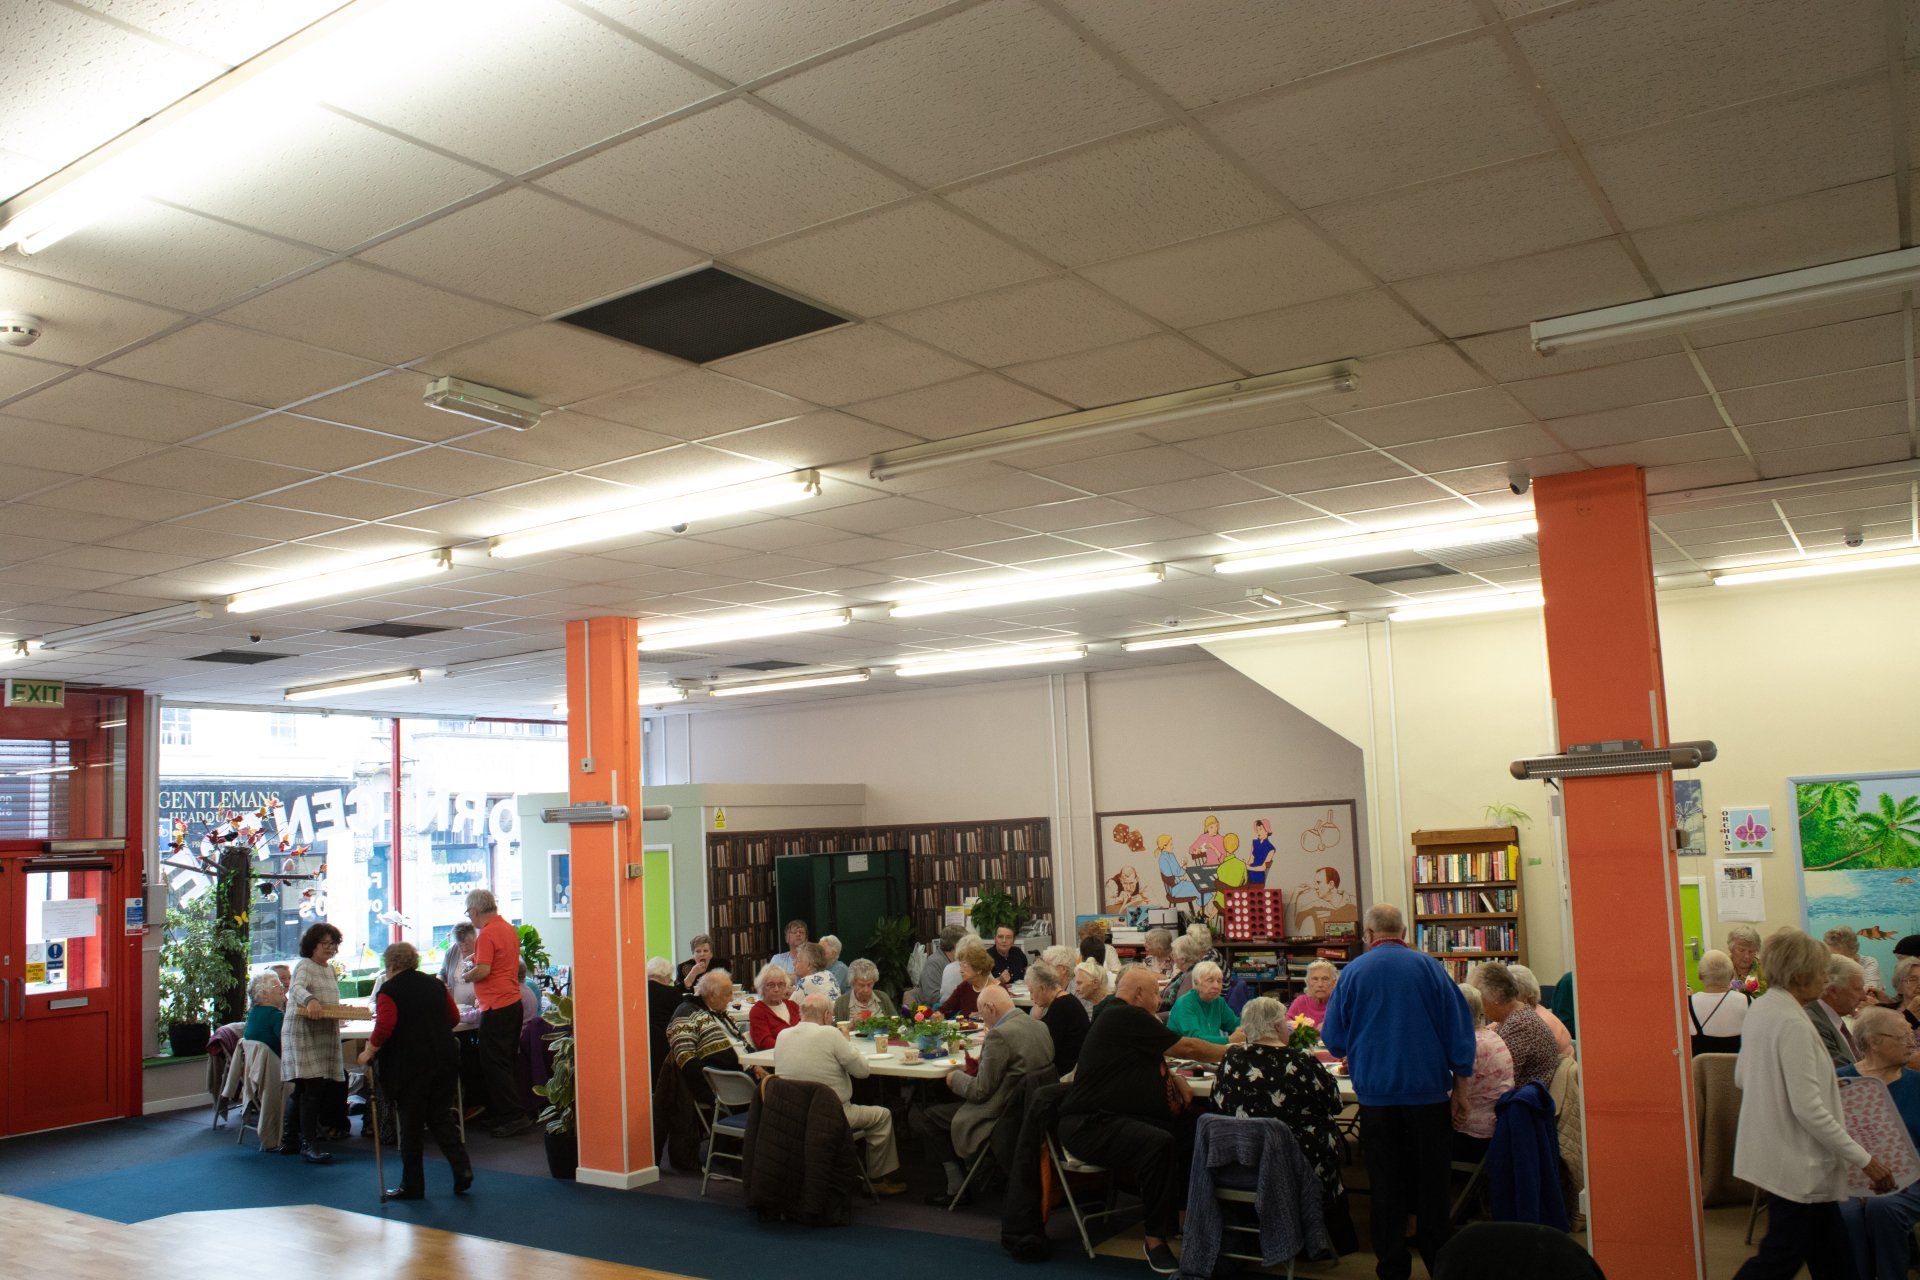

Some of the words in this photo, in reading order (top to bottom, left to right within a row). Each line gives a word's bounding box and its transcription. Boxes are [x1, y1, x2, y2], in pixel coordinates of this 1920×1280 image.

[12, 683, 63, 703] EXIT
[158, 790, 280, 809] GENTLEMANS
[169, 811, 270, 826] HEADQUART
[1721, 810, 1731, 851] ORCHIDS
